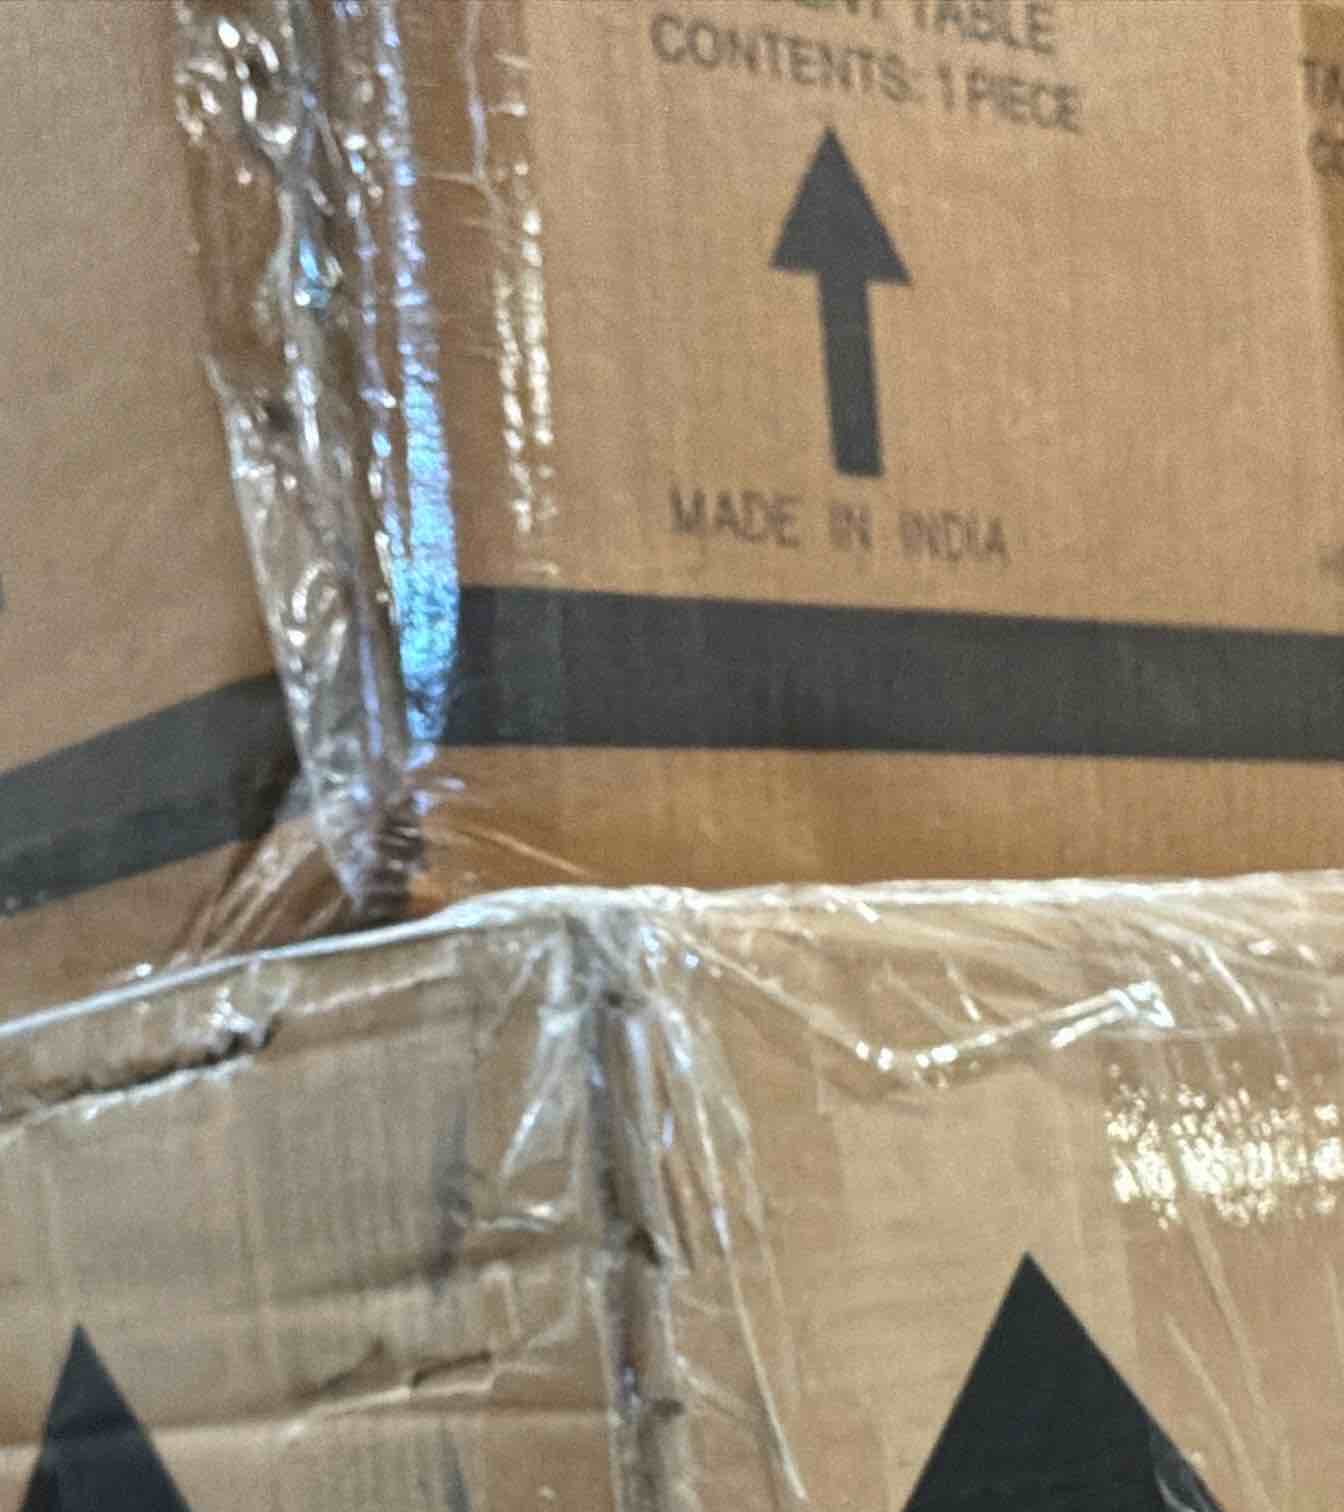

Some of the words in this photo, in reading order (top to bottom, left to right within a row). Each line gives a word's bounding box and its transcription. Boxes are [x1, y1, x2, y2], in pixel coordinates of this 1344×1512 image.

[670, 484, 802, 550] MADE
[830, 500, 874, 553] IN
[900, 507, 1012, 568] INDIA
